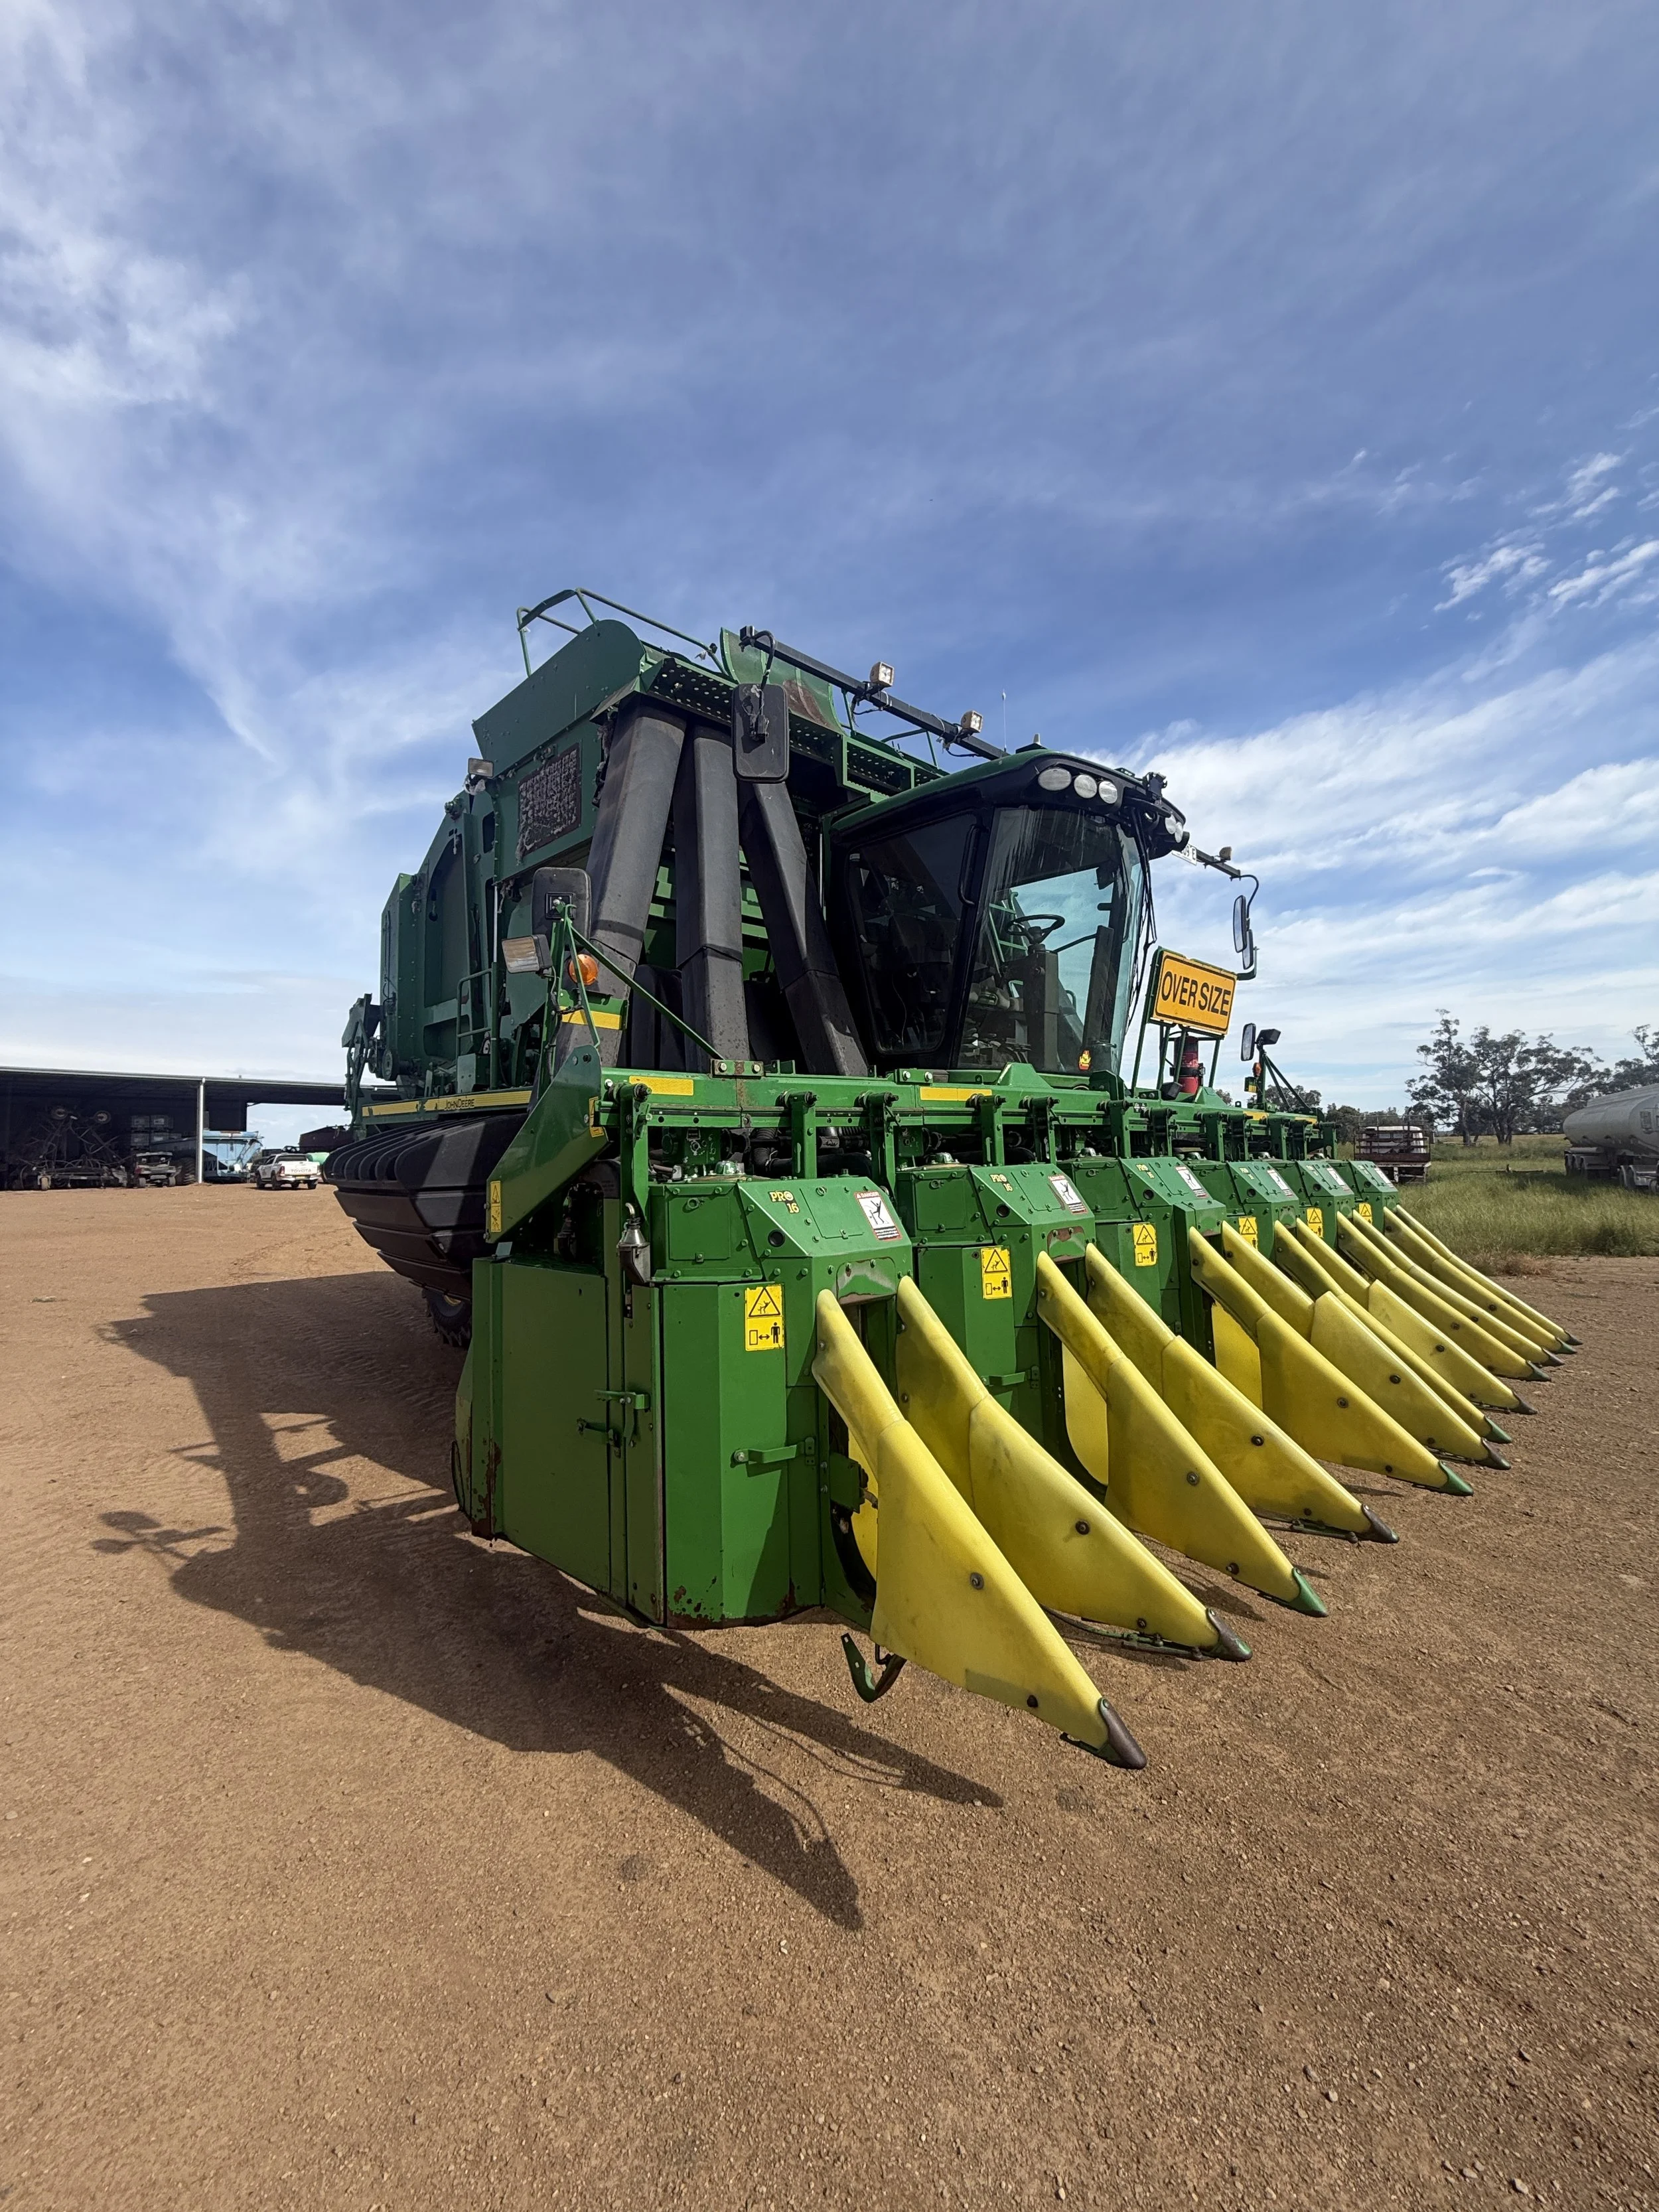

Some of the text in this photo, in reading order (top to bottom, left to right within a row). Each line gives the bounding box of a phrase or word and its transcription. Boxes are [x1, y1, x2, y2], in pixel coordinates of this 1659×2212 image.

[989, 1174, 1007, 1183] PRO
[769, 1191, 794, 1202] PRO
[787, 1203, 800, 1214] 16
